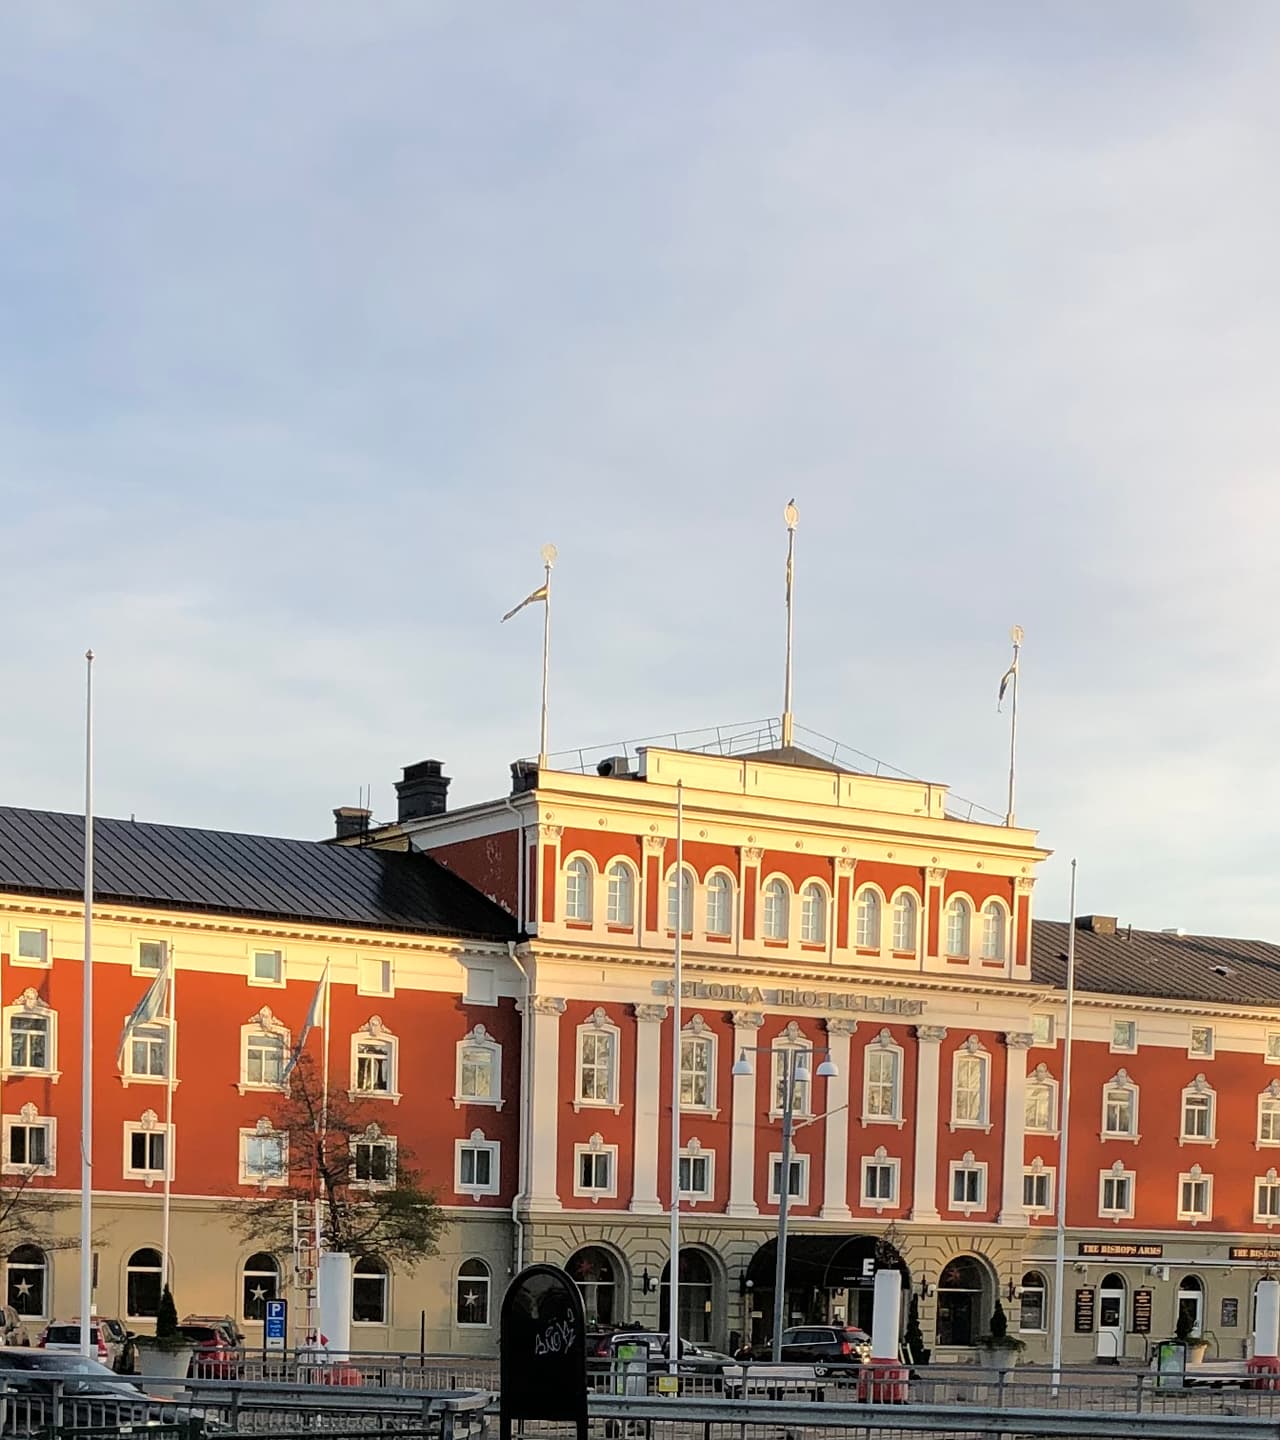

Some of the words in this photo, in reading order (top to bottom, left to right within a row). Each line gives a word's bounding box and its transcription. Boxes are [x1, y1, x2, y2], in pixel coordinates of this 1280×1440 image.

[1083, 1244, 1100, 1253] THE
[1101, 1245, 1137, 1255] BISHOPS
[1138, 1246, 1161, 1256] ARMS
